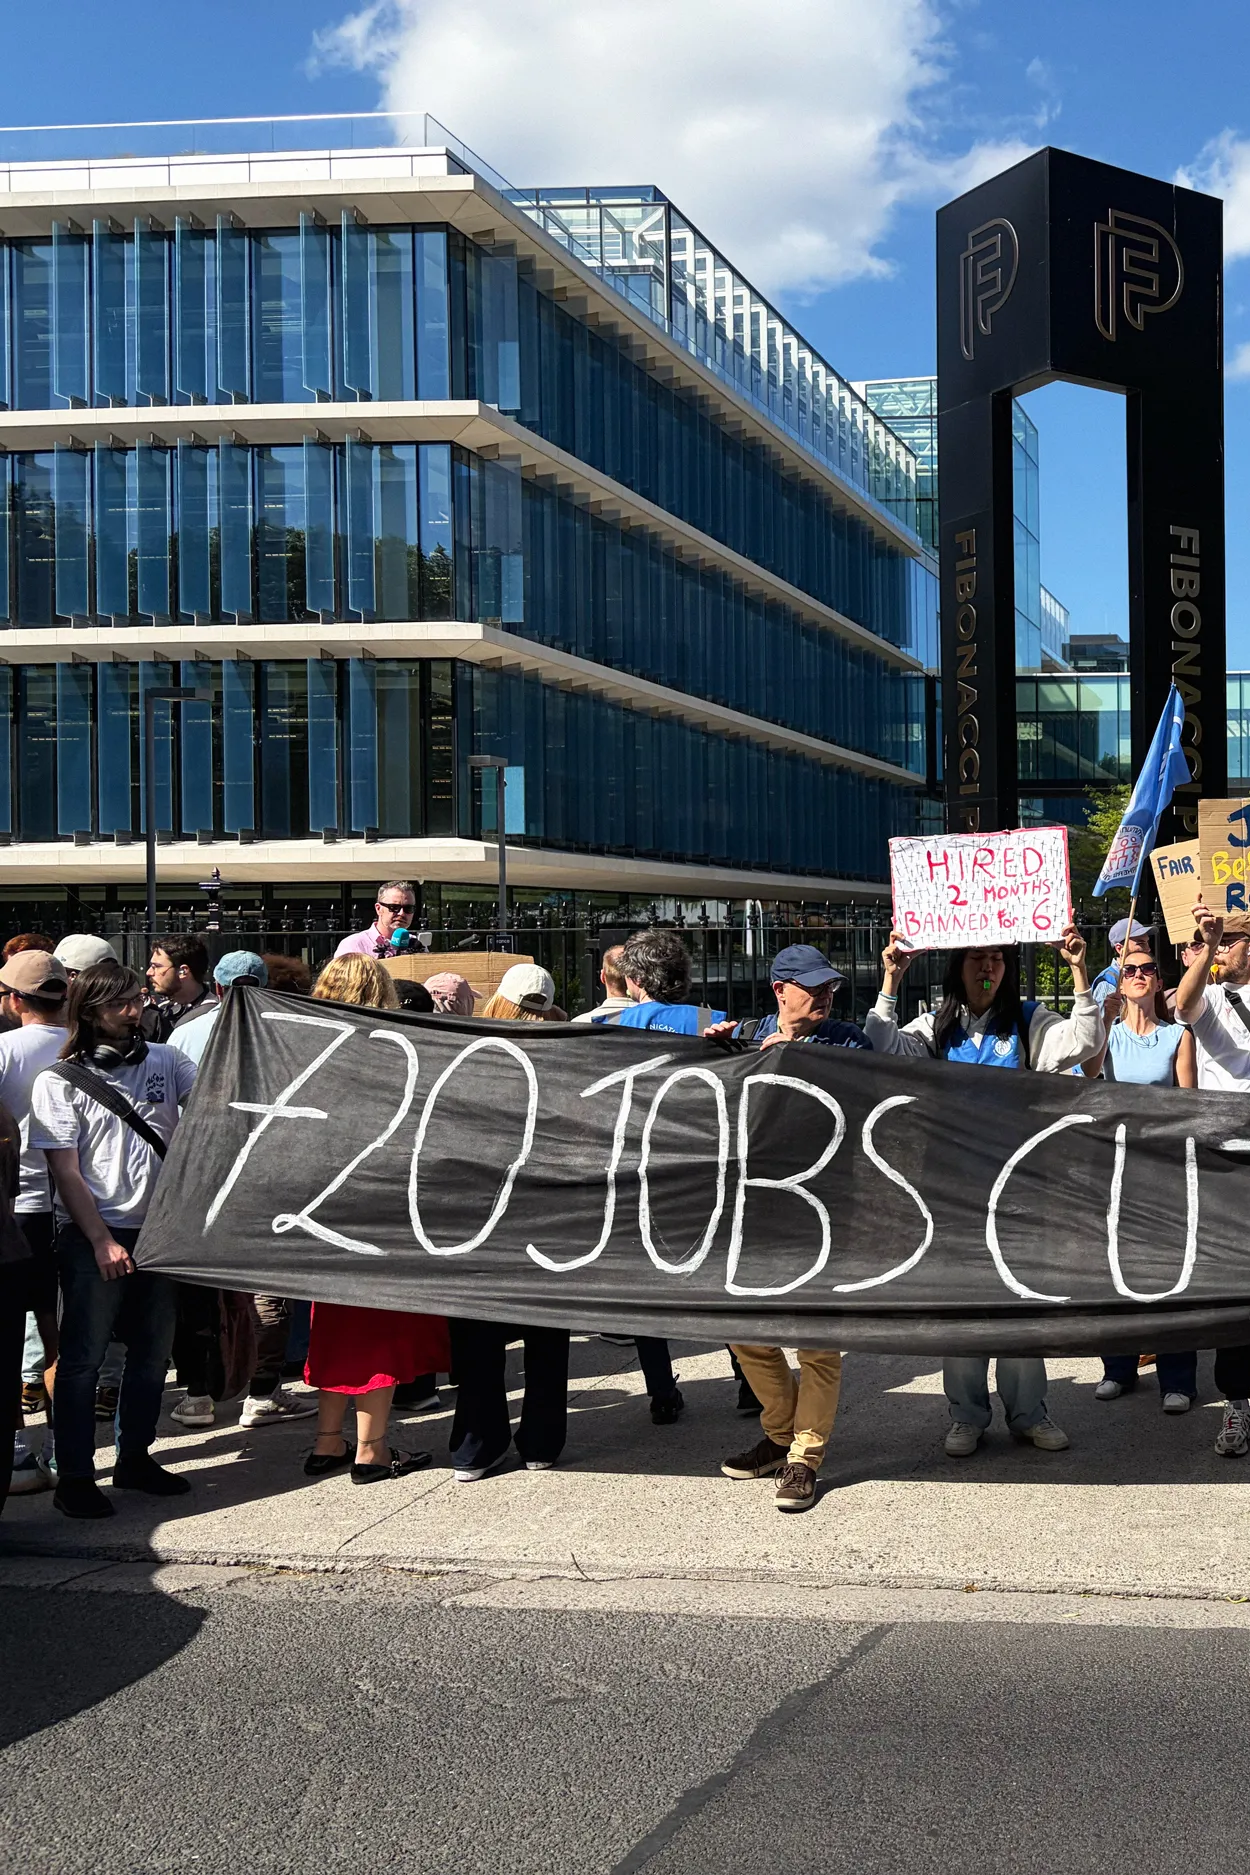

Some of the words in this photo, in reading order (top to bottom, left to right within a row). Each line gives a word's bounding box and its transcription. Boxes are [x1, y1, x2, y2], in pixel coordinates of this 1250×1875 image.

[955, 528, 980, 795] FIBONACCI
[926, 847, 1044, 883] HIRED
[1157, 855, 1196, 880] FAIR
[947, 885, 969, 906] 2
[983, 879, 1051, 903] MONTHS
[904, 911, 989, 936] BANNED
[1032, 898, 1052, 931] 6
[203, 1011, 540, 1257] 720
[525, 1052, 935, 1297] JOBS
